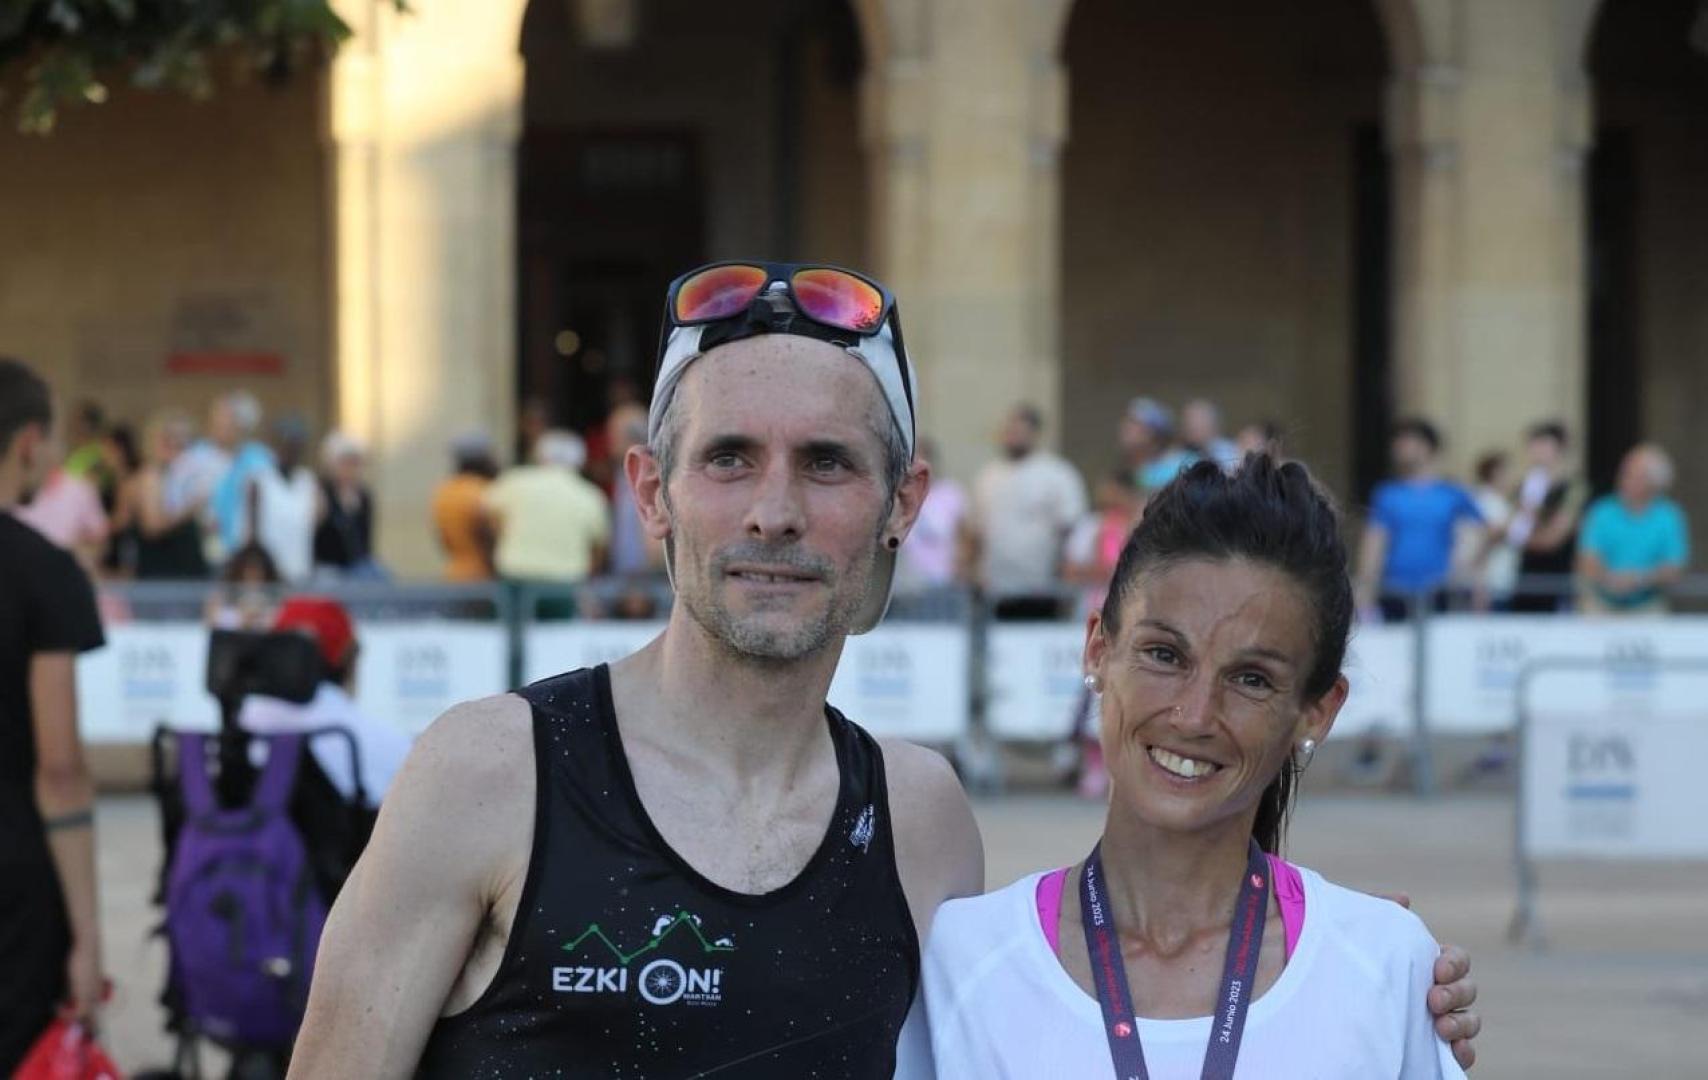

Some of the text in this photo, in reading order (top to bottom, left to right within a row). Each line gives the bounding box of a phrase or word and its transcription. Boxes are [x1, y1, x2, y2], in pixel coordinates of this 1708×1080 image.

[1092, 901, 1104, 926] 2023
[552, 958, 721, 1005] EZKI ON!
[1220, 1027, 1231, 1044] 24
[1229, 980, 1242, 1004] 2023
